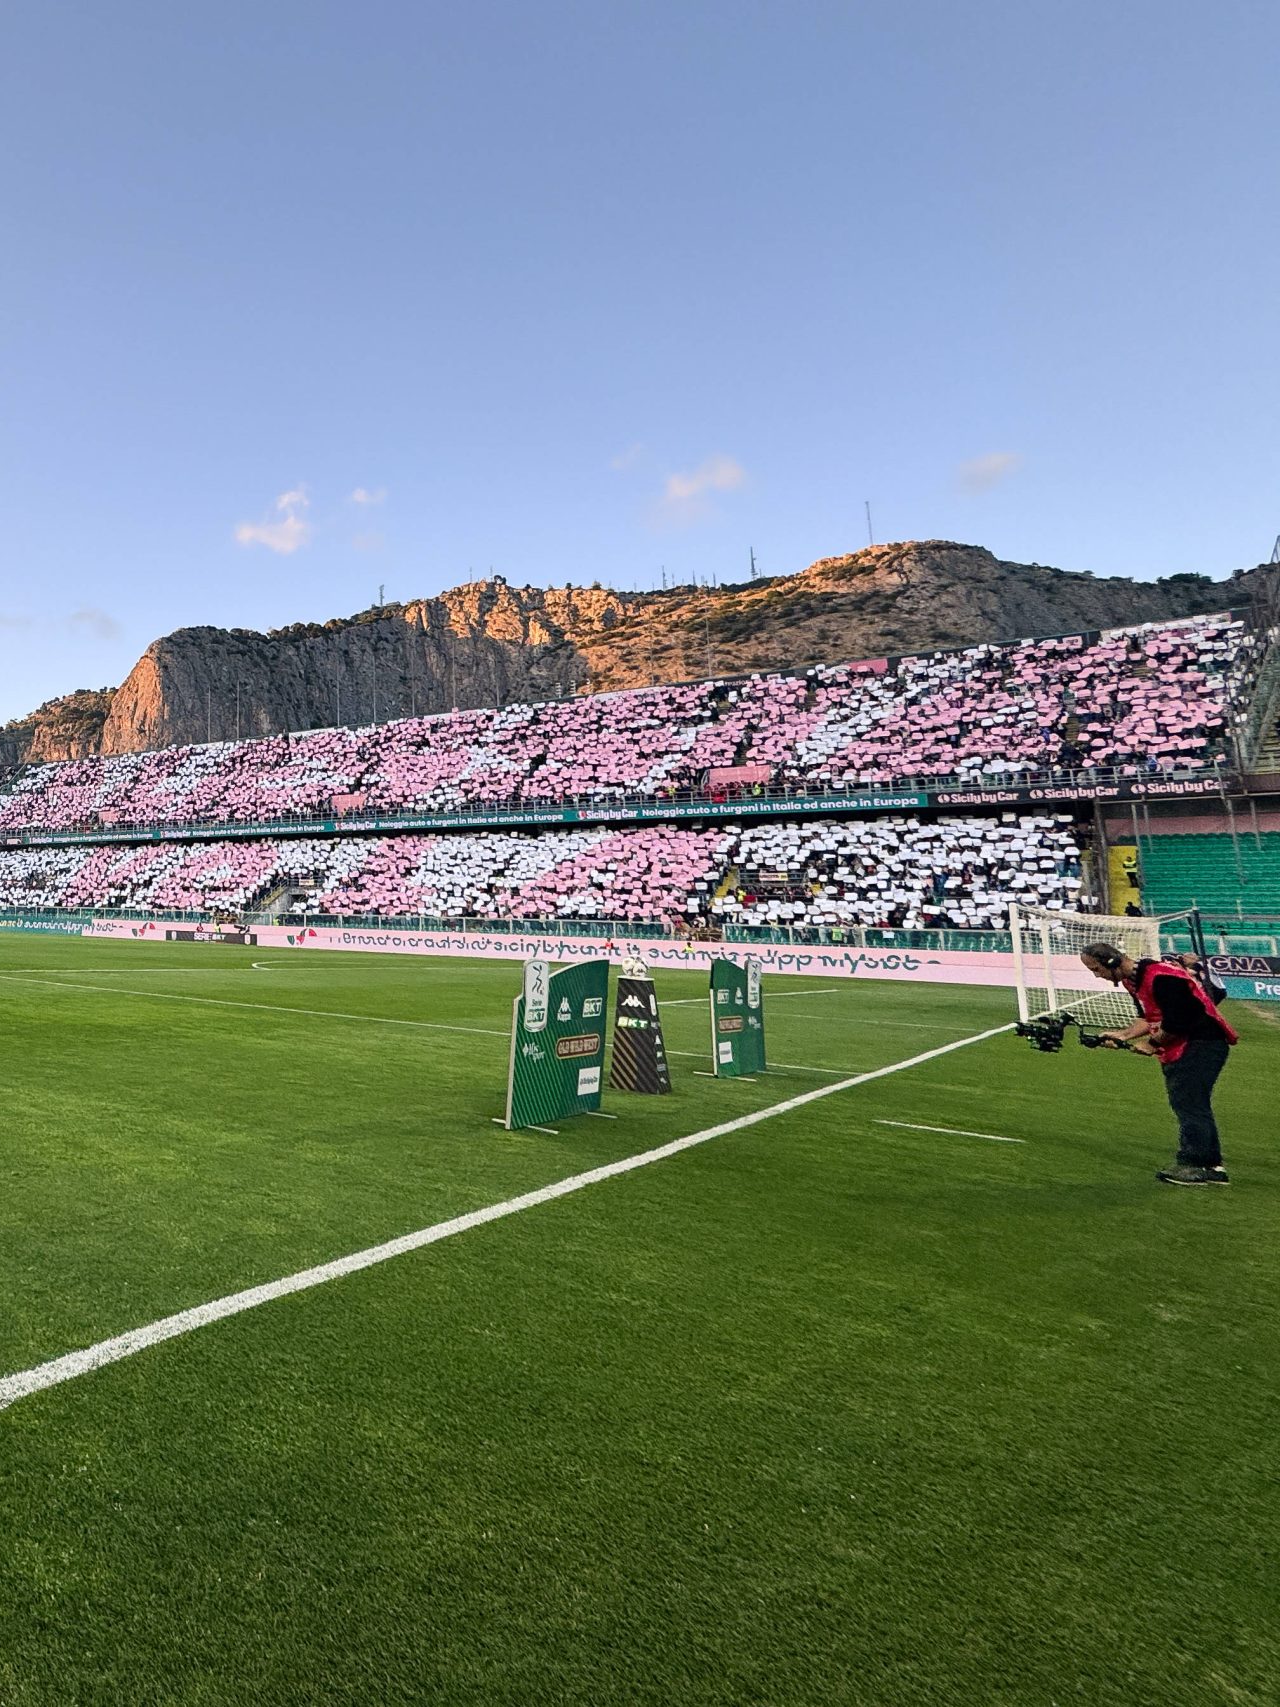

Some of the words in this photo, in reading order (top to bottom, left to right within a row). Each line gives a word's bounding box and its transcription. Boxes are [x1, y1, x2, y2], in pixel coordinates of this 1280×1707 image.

[642, 808, 685, 817] Noleggio
[720, 803, 759, 813] furgoni
[760, 803, 771, 811] in
[773, 802, 801, 811] Italia
[803, 800, 818, 810] ed
[821, 799, 858, 809] anche
[860, 798, 871, 807] in
[873, 798, 918, 807] Europa
[432, 818, 458, 826] furgoni
[525, 814, 533, 822] in
[534, 814, 564, 822] Europa
[618, 1017, 648, 1028] BKT
